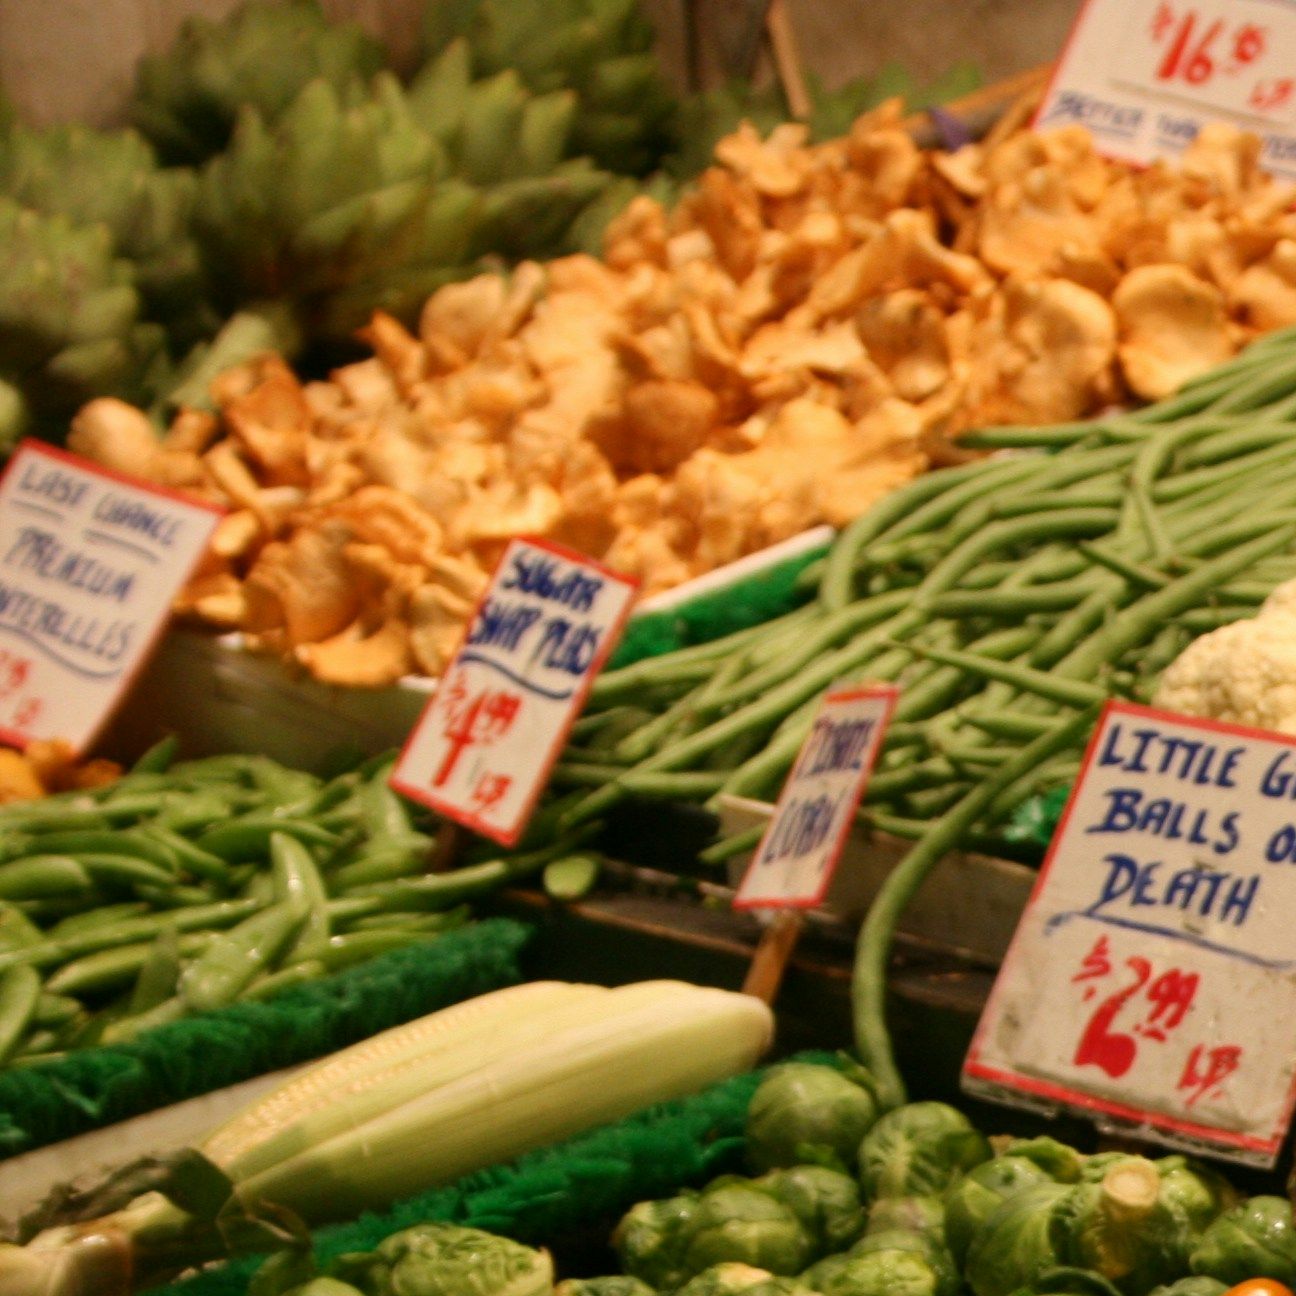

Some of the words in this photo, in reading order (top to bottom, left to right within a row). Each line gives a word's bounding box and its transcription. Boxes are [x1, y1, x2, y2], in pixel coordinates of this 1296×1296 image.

[502, 552, 603, 611] SUGAR
[1100, 723, 1247, 790] LITTLE
[1086, 788, 1242, 857] BALLS
[1092, 853, 1261, 927] DEATH
